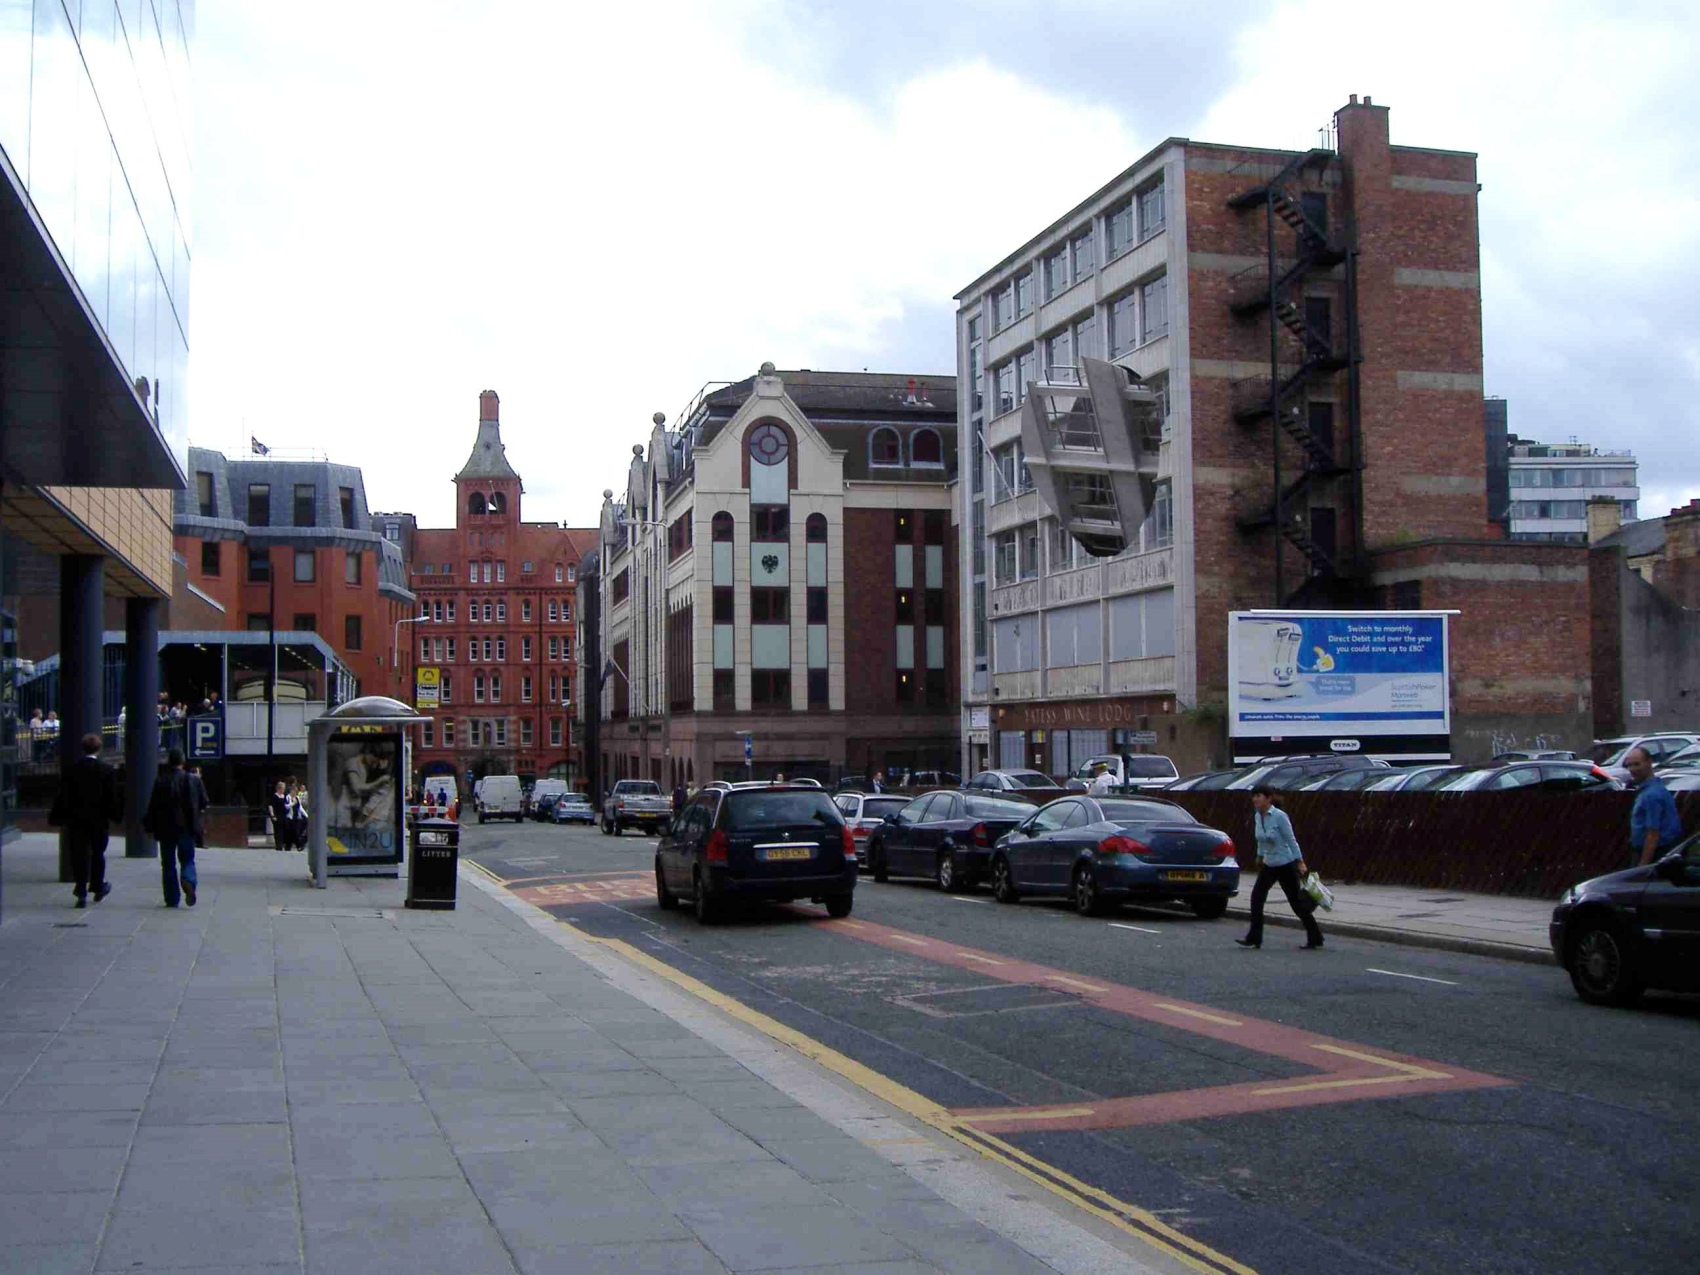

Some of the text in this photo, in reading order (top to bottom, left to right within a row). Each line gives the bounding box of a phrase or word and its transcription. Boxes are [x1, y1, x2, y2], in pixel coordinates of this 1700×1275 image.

[1347, 624, 1413, 635] Switch to monthly
[1328, 635, 1350, 643] Direct
[1351, 635, 1371, 643] Debit
[1373, 635, 1386, 643] and
[1404, 635, 1416, 643] the
[1417, 636, 1433, 645] year
[1336, 646, 1349, 655] you
[1350, 645, 1370, 653] could
[1388, 646, 1397, 655] up
[1399, 645, 1407, 653] to
[1063, 705, 1092, 722] WINE
[195, 722, 215, 748] P
[421, 850, 451, 858] LITTER
